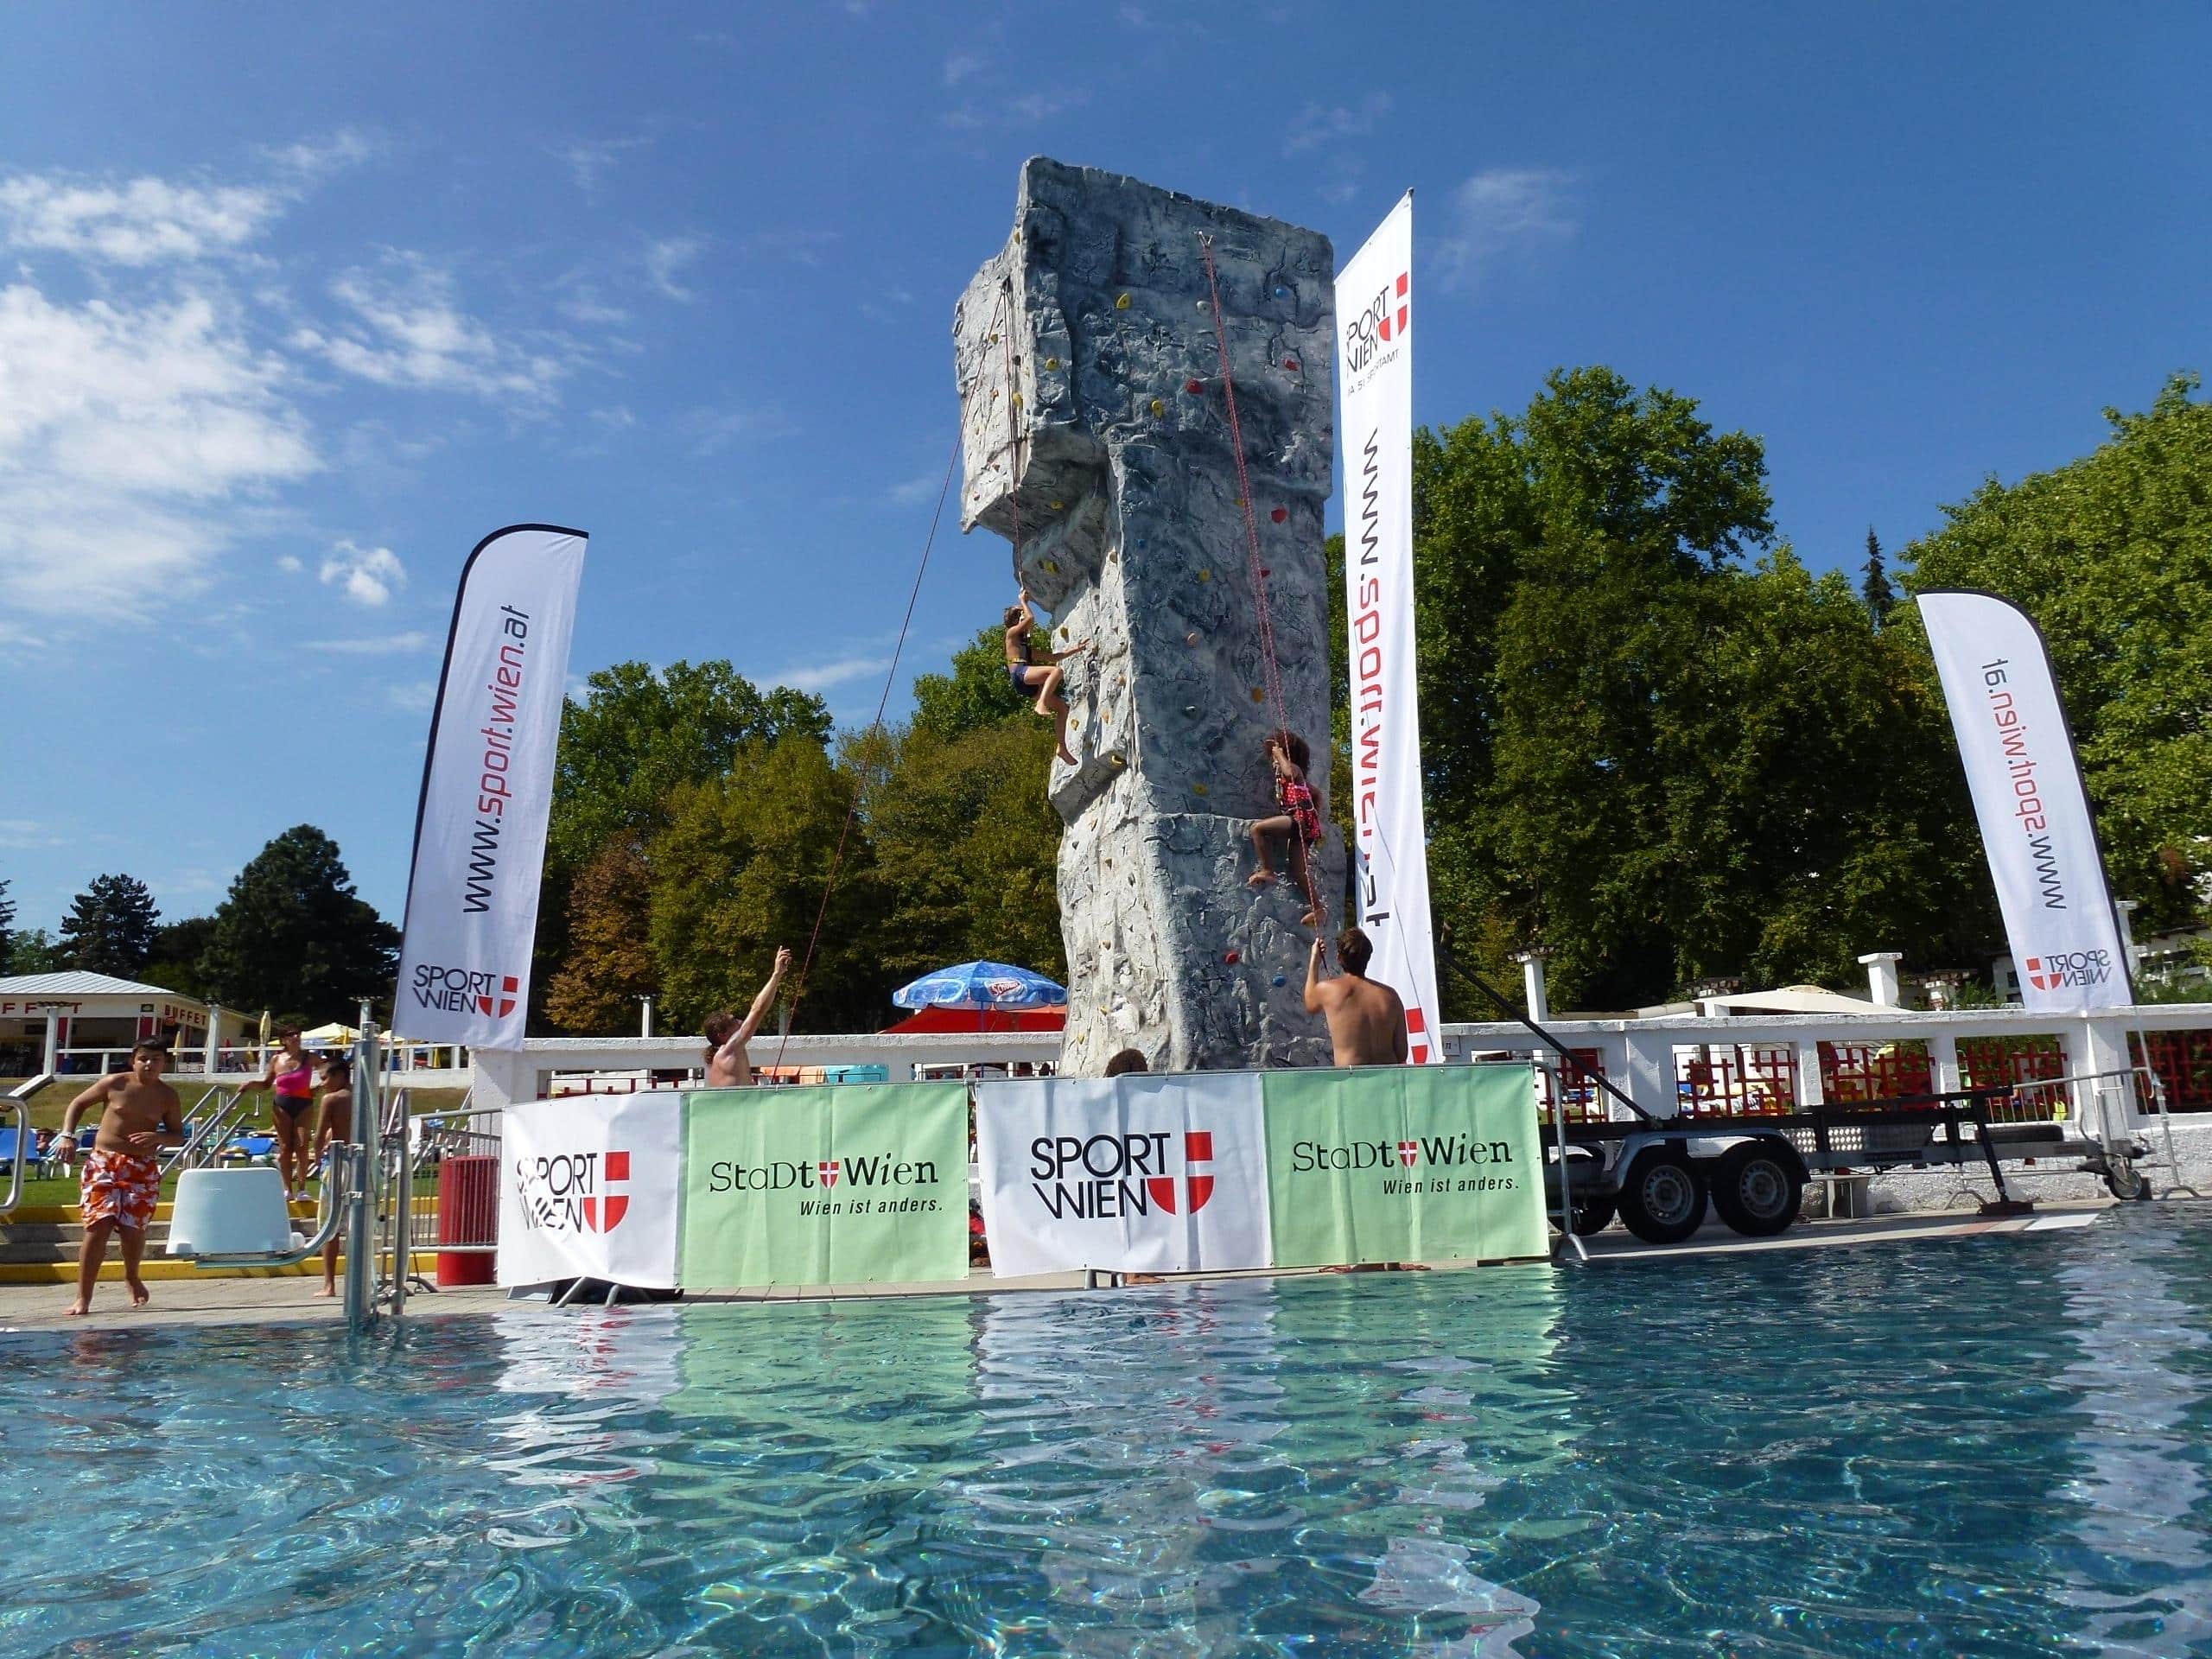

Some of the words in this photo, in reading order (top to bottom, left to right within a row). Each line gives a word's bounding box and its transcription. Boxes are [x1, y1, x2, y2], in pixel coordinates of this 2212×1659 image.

[463, 605, 530, 913] www.sport.wien.at
[413, 964, 496, 995] SPORT
[165, 1004, 207, 1026] BUFFET
[412, 987, 477, 1014] WIEN
[1030, 1133, 1171, 1180] SPORT
[1421, 1133, 1513, 1166] Wien
[843, 1152, 939, 1186] Wien
[1032, 1179, 1147, 1219] WIEN
[1382, 1179, 1423, 1195] Wien
[1430, 1178, 1452, 1193] ist
[1458, 1177, 1520, 1192] anders.
[800, 1200, 842, 1216] Wien
[849, 1198, 873, 1214] ist
[878, 1197, 944, 1213] anders.
